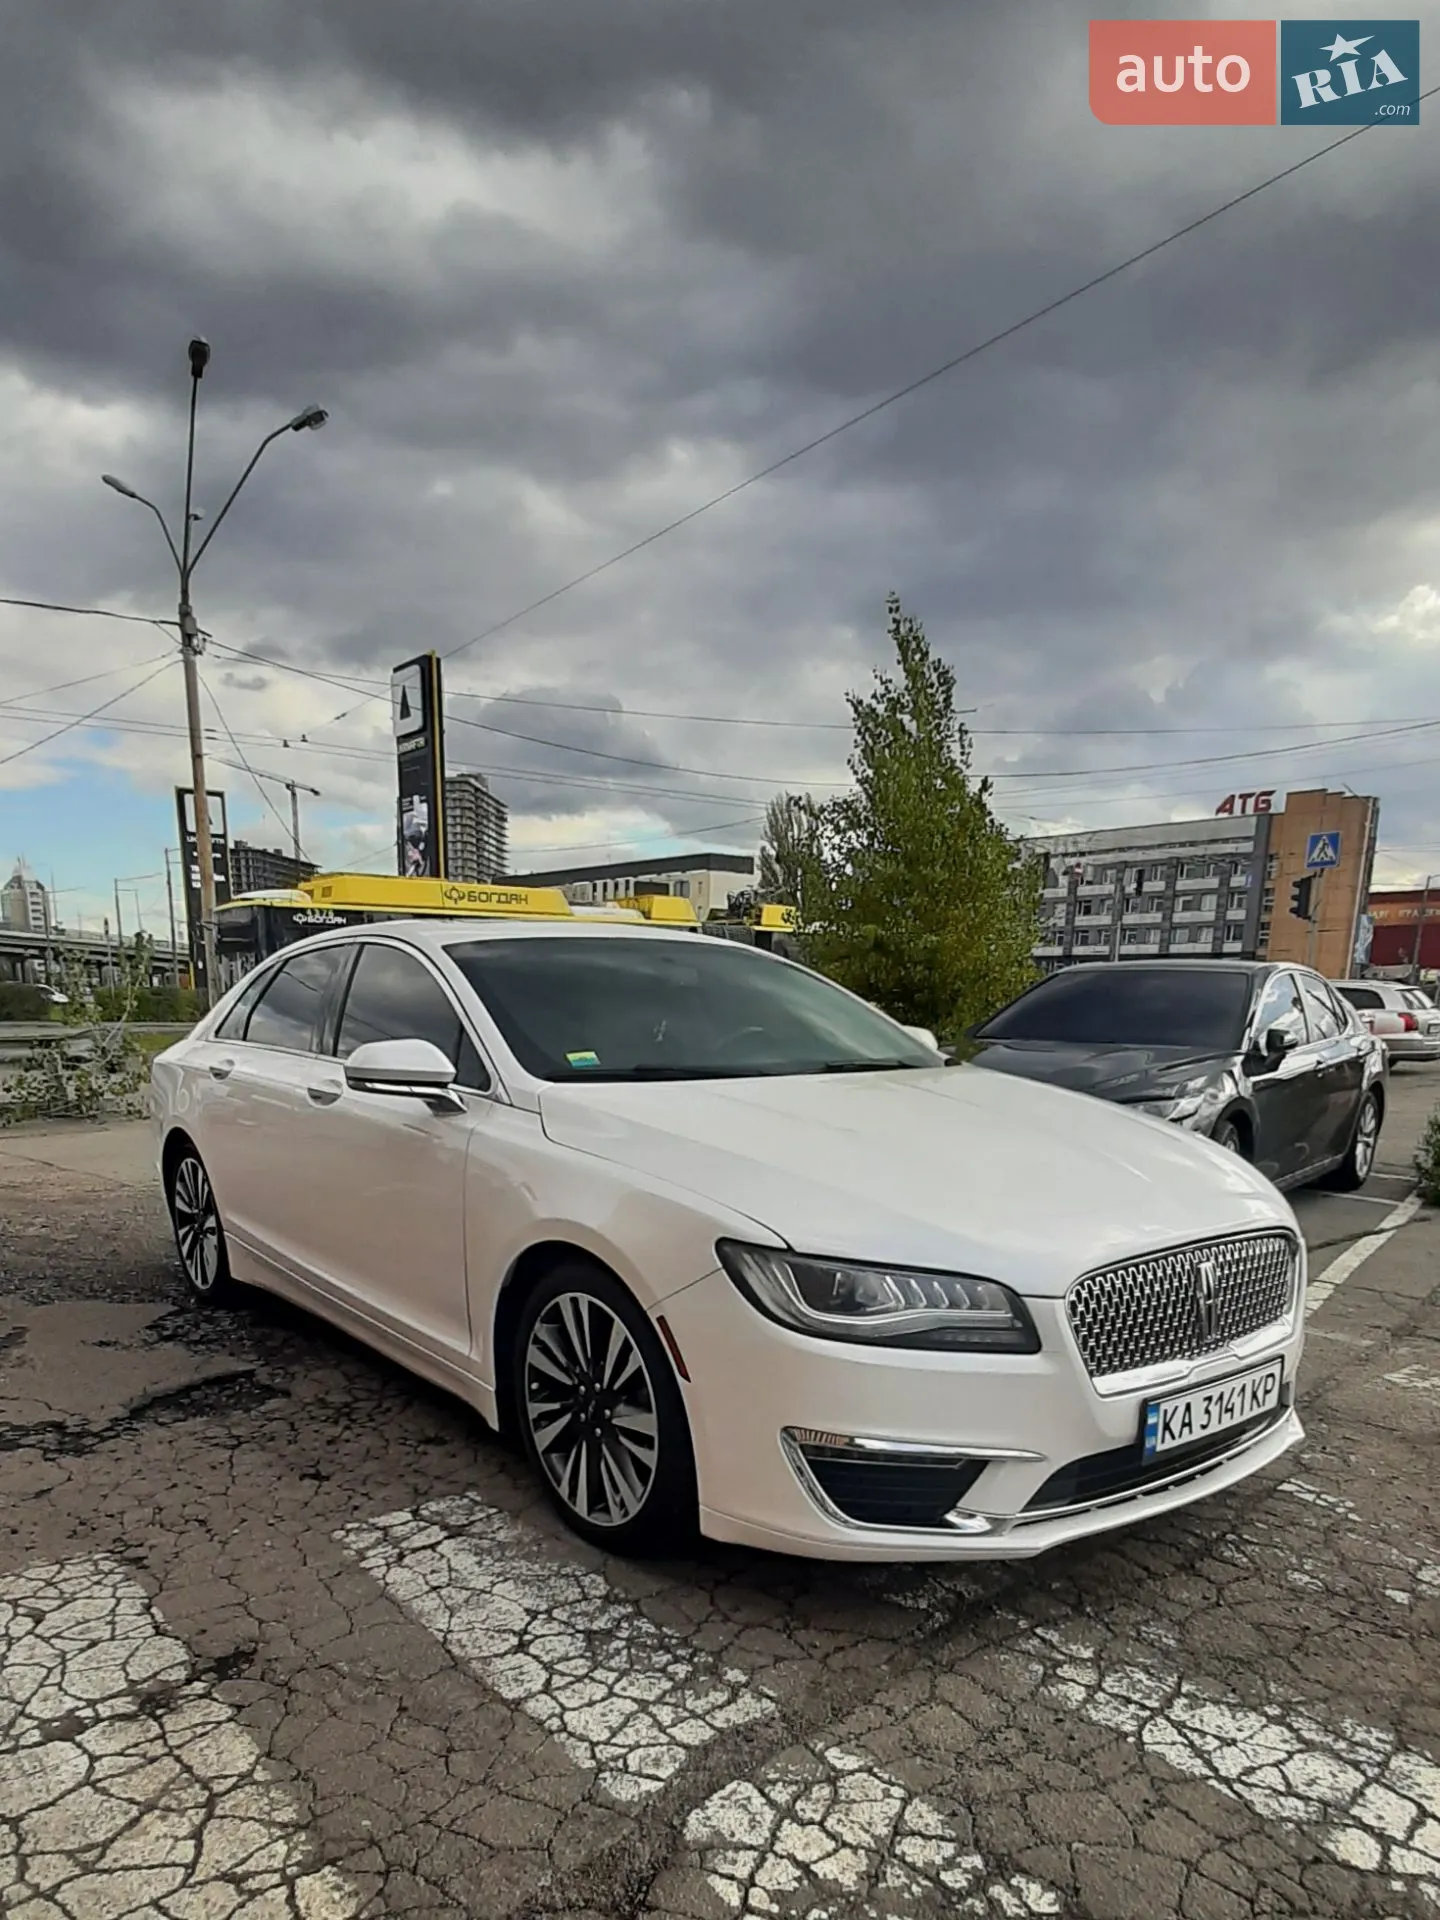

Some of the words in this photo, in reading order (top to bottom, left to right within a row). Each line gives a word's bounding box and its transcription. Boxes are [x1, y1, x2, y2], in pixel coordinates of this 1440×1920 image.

[1215, 790, 1276, 816] АТБ
[467, 891, 528, 904] БОГДАН
[1160, 1402, 1193, 1444] KA
[1200, 1383, 1246, 1431] 3141
